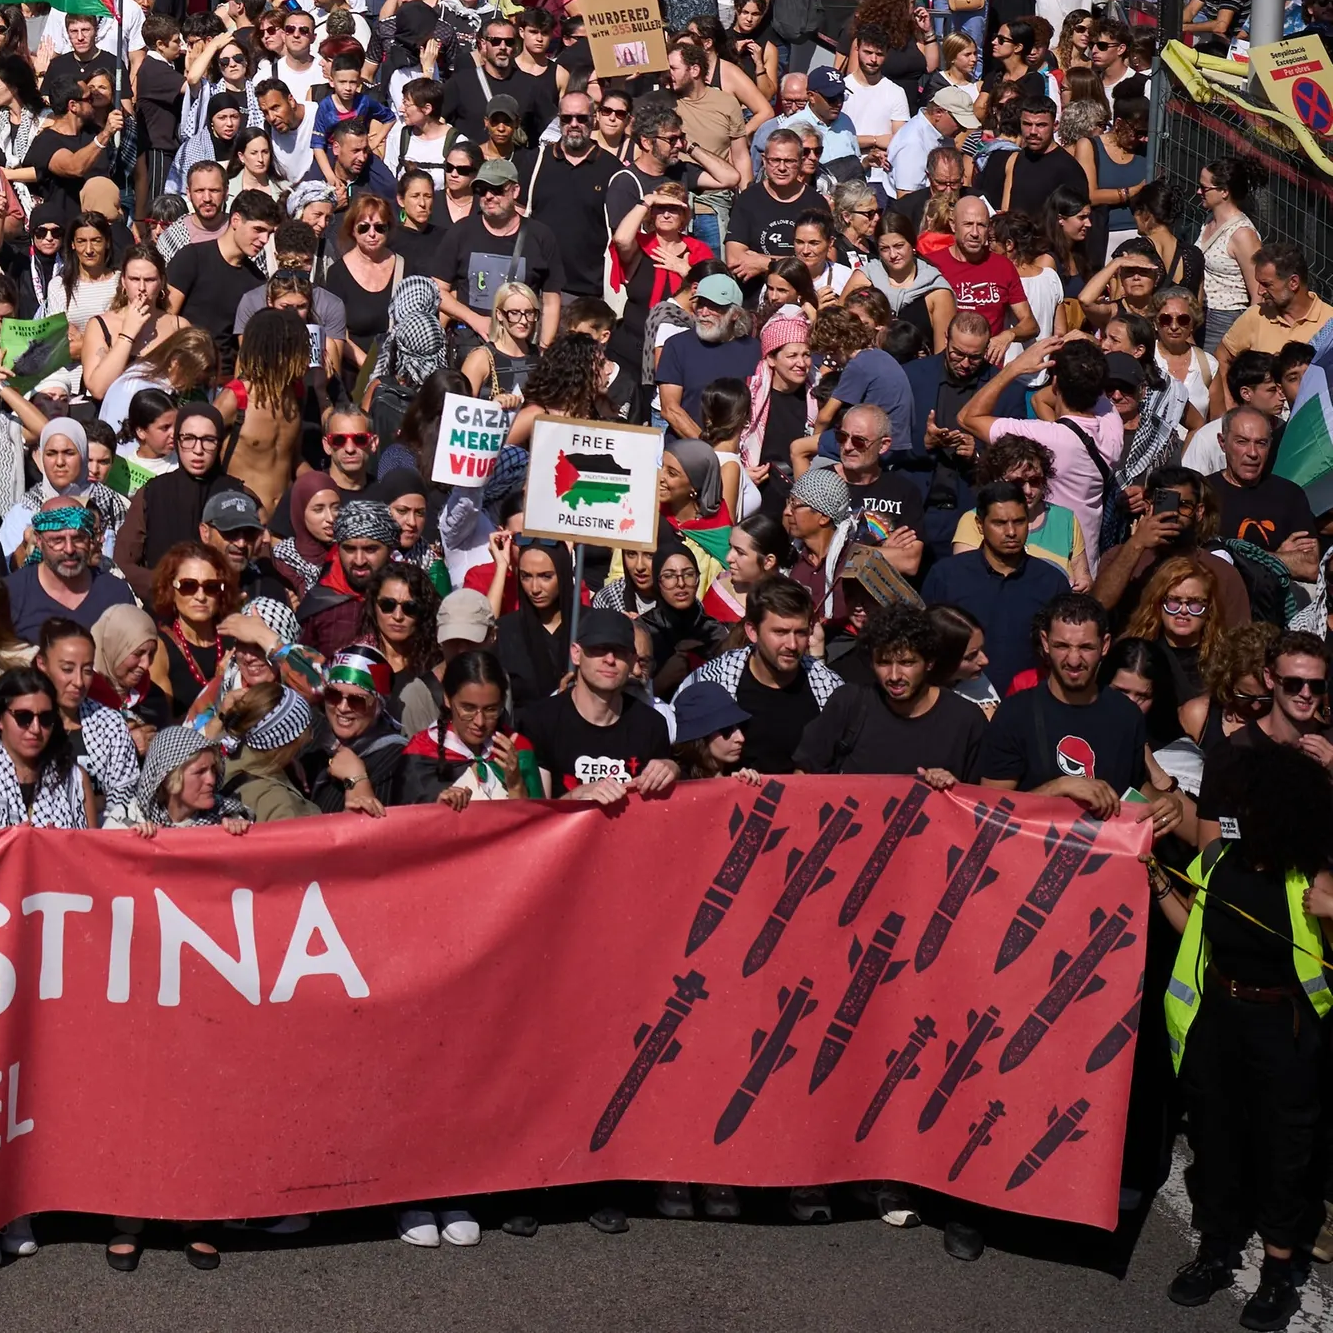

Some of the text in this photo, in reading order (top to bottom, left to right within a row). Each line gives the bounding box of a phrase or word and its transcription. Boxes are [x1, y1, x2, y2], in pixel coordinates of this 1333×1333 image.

[588, 7, 650, 26] MURDERED
[612, 23, 632, 37] 355
[632, 20, 661, 34] BULLETS
[1270, 46, 1306, 59] Senyalització
[1275, 55, 1308, 68] Excepcional
[1283, 65, 1311, 78] Per obres
[455, 405, 511, 429] GAZA
[572, 433, 615, 451] FREE
[558, 513, 614, 531] PALESTINE
